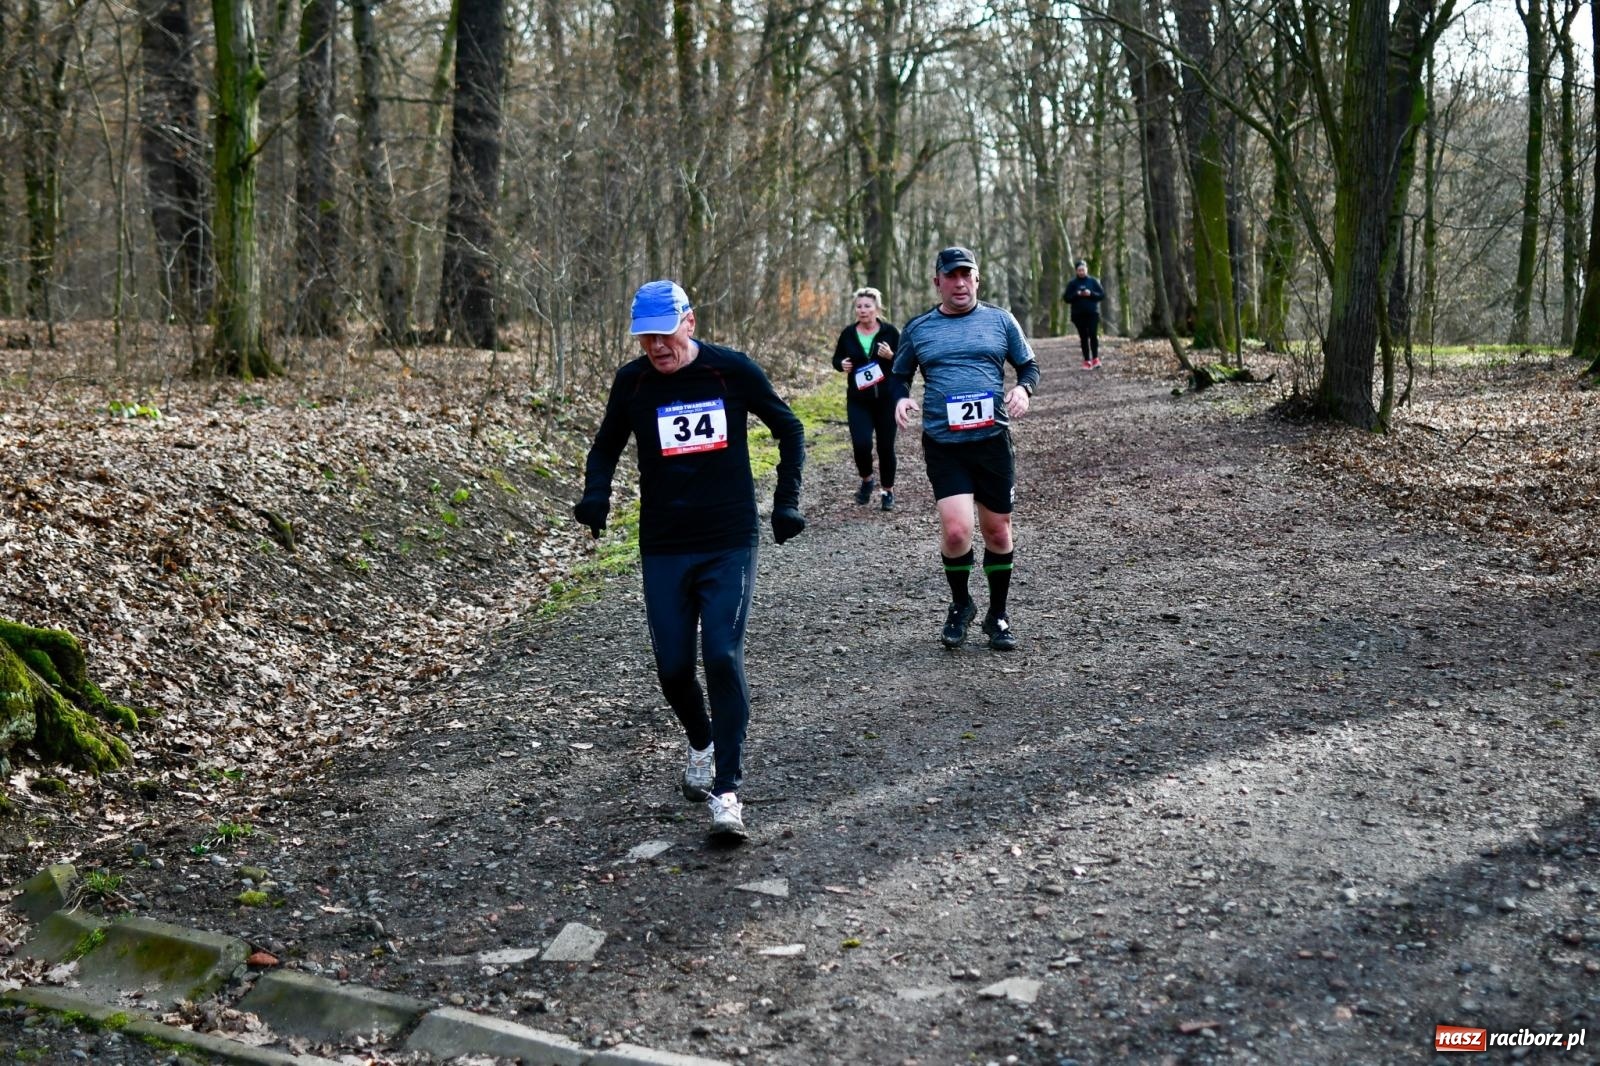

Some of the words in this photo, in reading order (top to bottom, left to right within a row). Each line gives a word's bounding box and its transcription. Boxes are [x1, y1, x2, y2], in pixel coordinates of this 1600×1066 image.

[864, 370, 873, 381] 8
[961, 401, 983, 421] 21
[673, 413, 715, 442] 34
